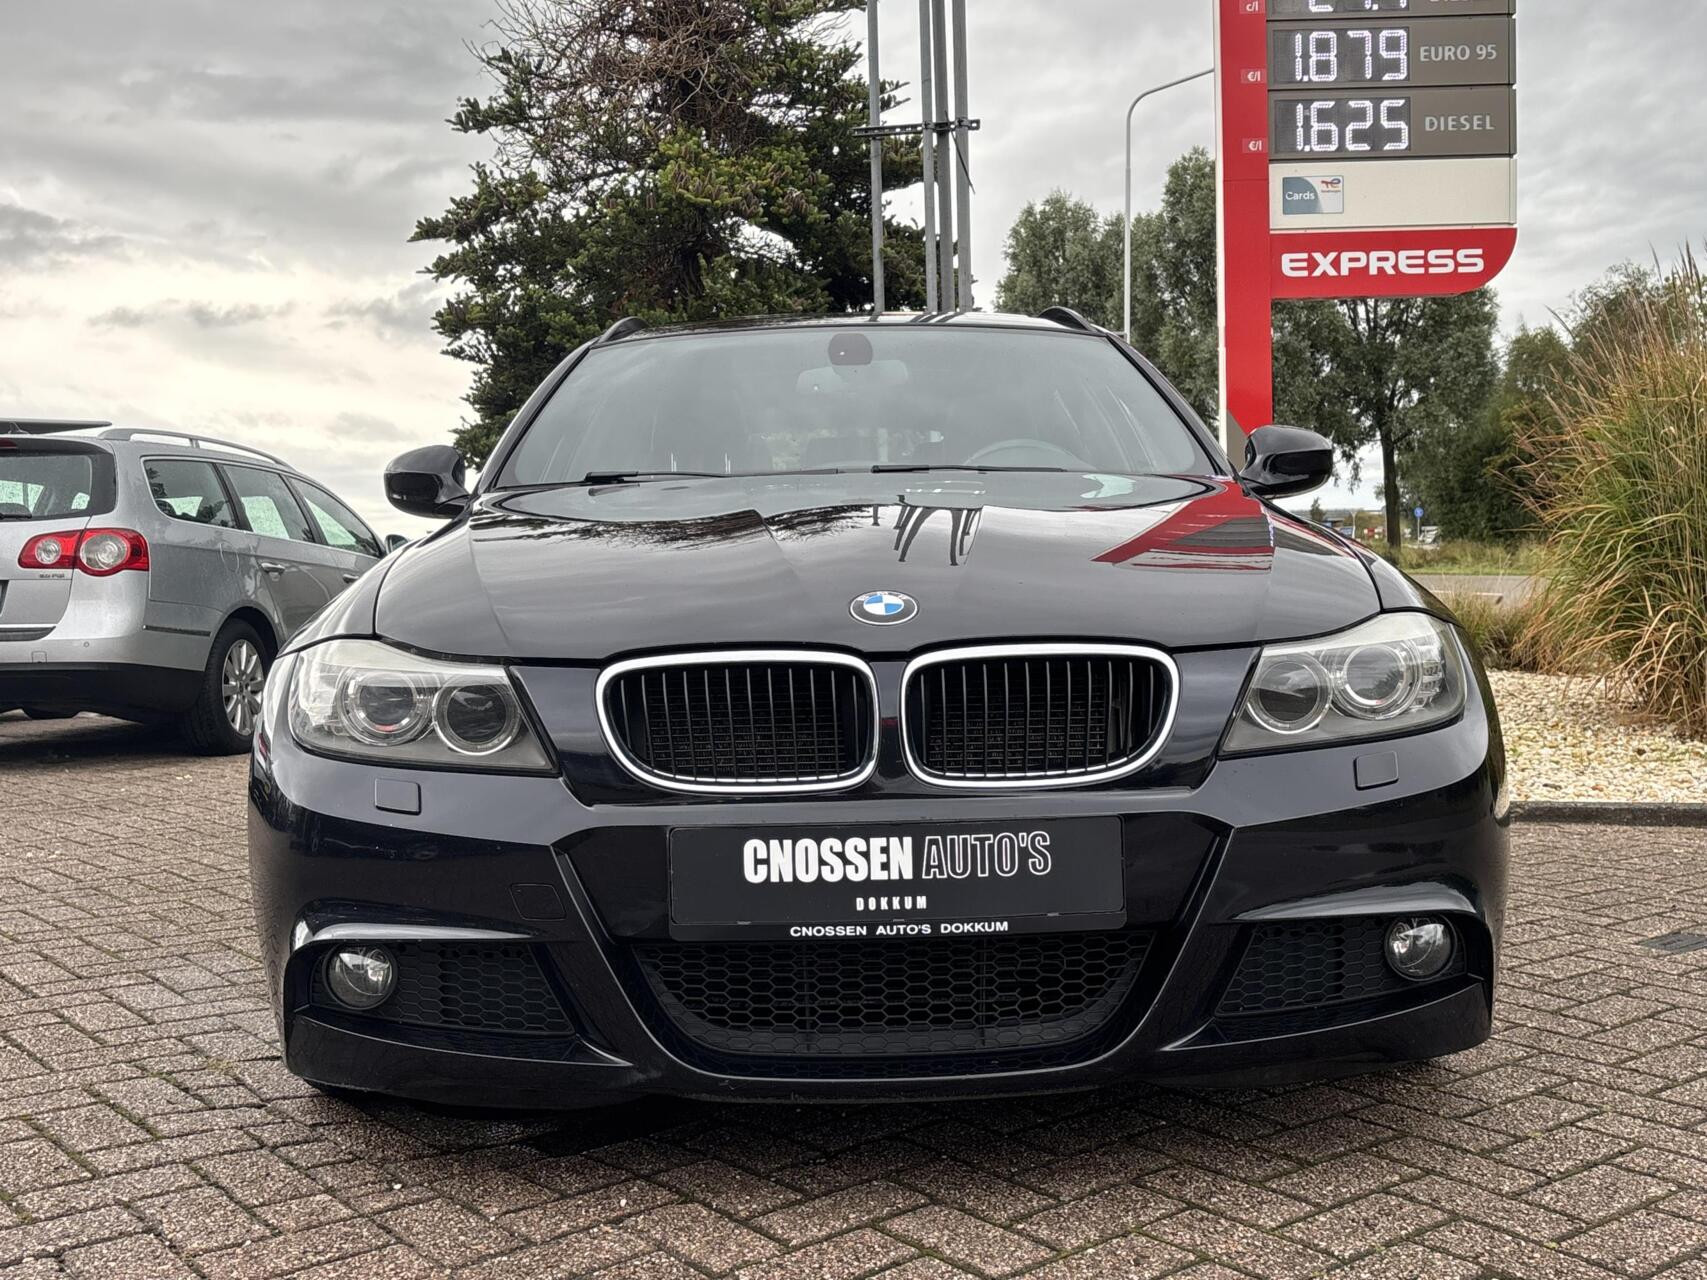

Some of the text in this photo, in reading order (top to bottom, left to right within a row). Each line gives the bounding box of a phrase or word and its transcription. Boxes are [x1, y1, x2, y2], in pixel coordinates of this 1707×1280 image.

[1295, 29, 1497, 82] 1.879 EURO 95
[1296, 99, 1495, 151] 1.625 DIESEL
[1285, 191, 1316, 201] Cards
[1281, 248, 1485, 277] EXPRESS
[743, 831, 1052, 884] CNOSSEN AUTO'S
[856, 896, 927, 911] DOKKUM
[789, 921, 1009, 938] CNOSSEN AUTO'S DOKKUM
